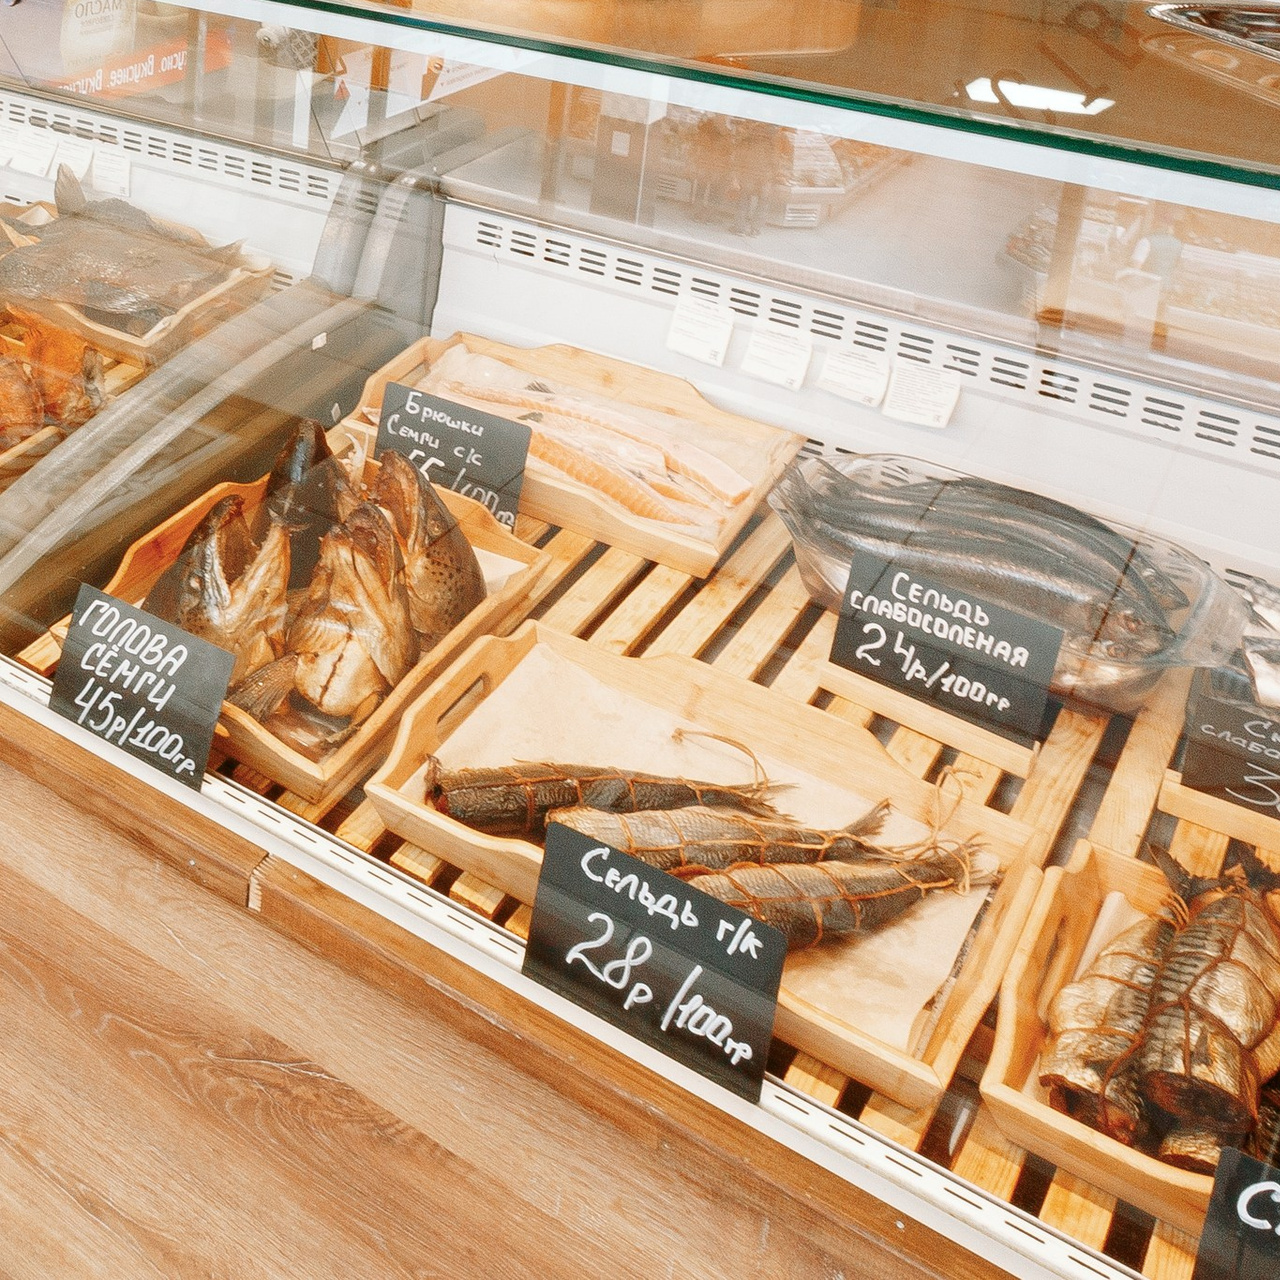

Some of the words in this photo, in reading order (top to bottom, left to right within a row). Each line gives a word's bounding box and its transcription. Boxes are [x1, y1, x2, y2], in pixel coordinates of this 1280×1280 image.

[404, 391, 484, 437] Брюшки
[78, 599, 188, 677] ГОЛОВА
[850, 590, 1030, 668] СЛАБОСОЛЕНАЯ
[716, 918, 764, 959] г/к
